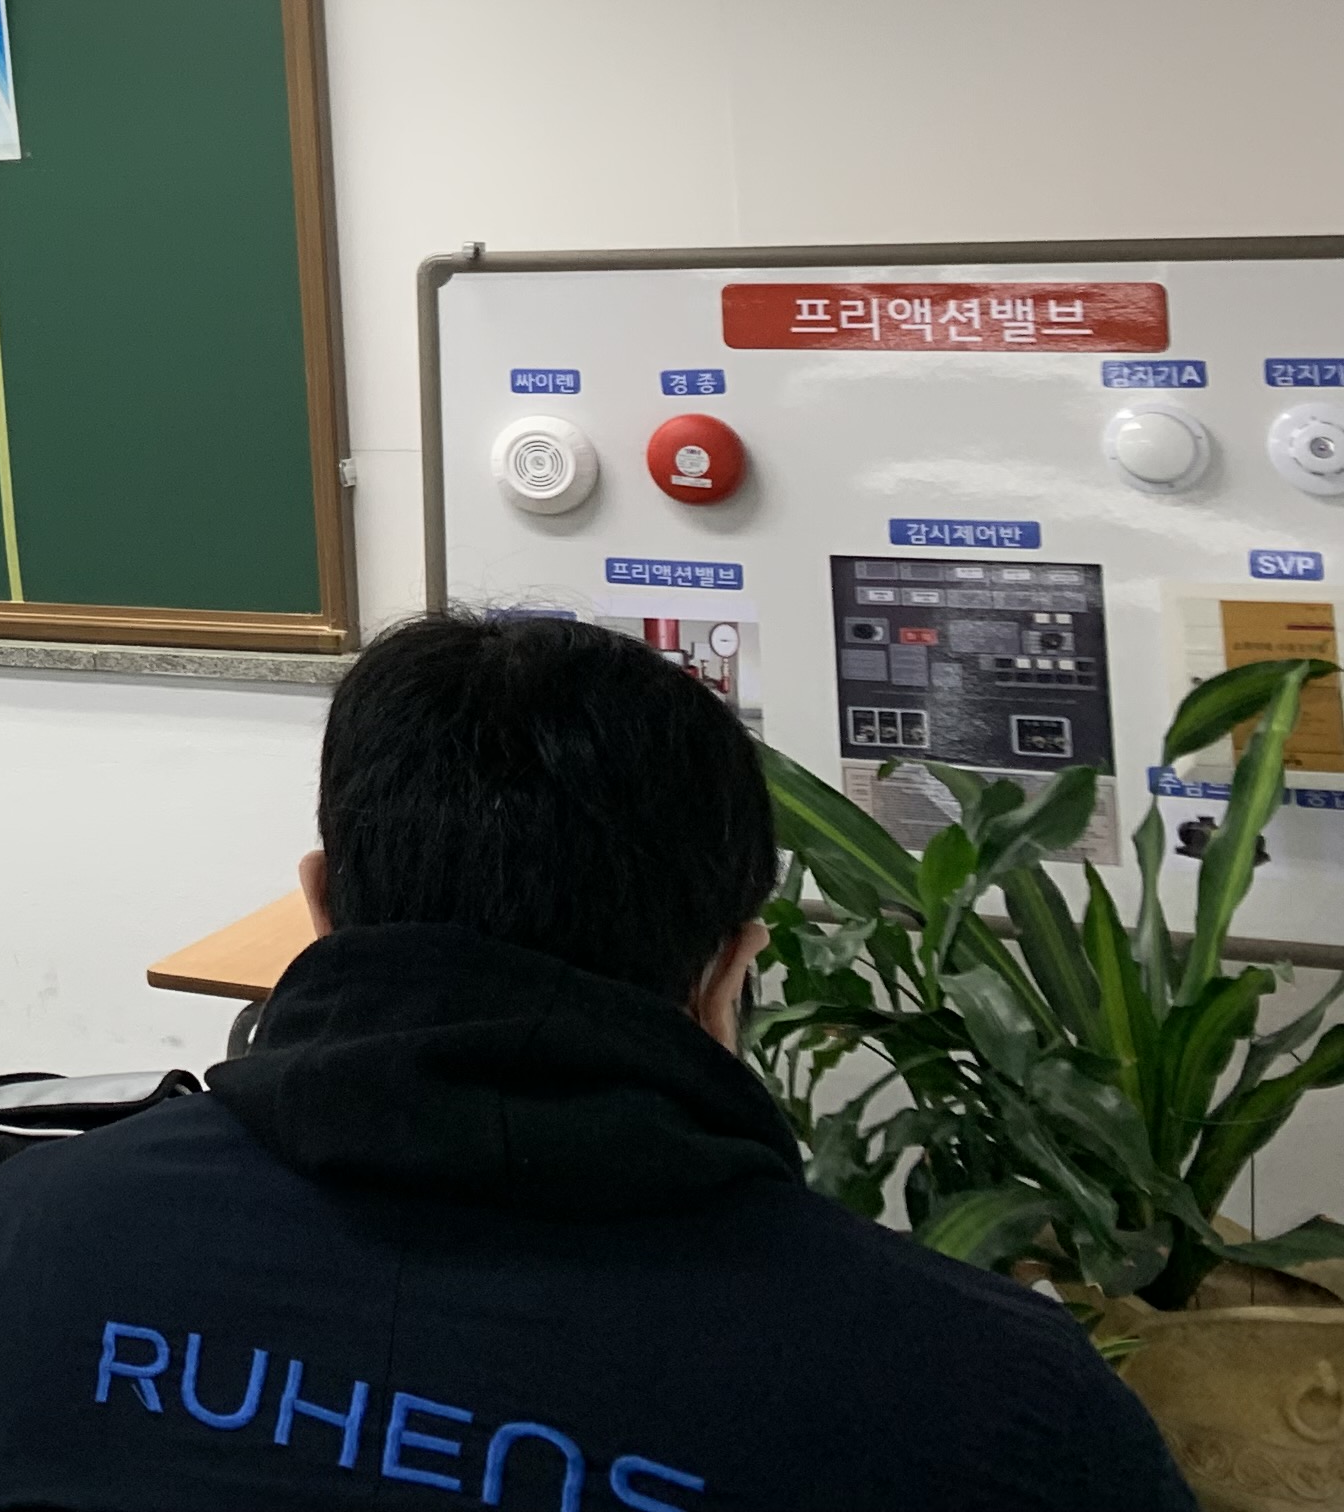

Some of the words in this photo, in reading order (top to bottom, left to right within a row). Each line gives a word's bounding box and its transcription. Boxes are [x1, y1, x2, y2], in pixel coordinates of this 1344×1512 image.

[790, 297, 1094, 344] 프리액션밸브
[515, 373, 575, 393] 싸이렌
[1107, 364, 1202, 388] 감지기A
[905, 523, 1024, 548] 감시제어반
[611, 562, 738, 587] 프리액션밸브
[1258, 555, 1316, 576] SVP
